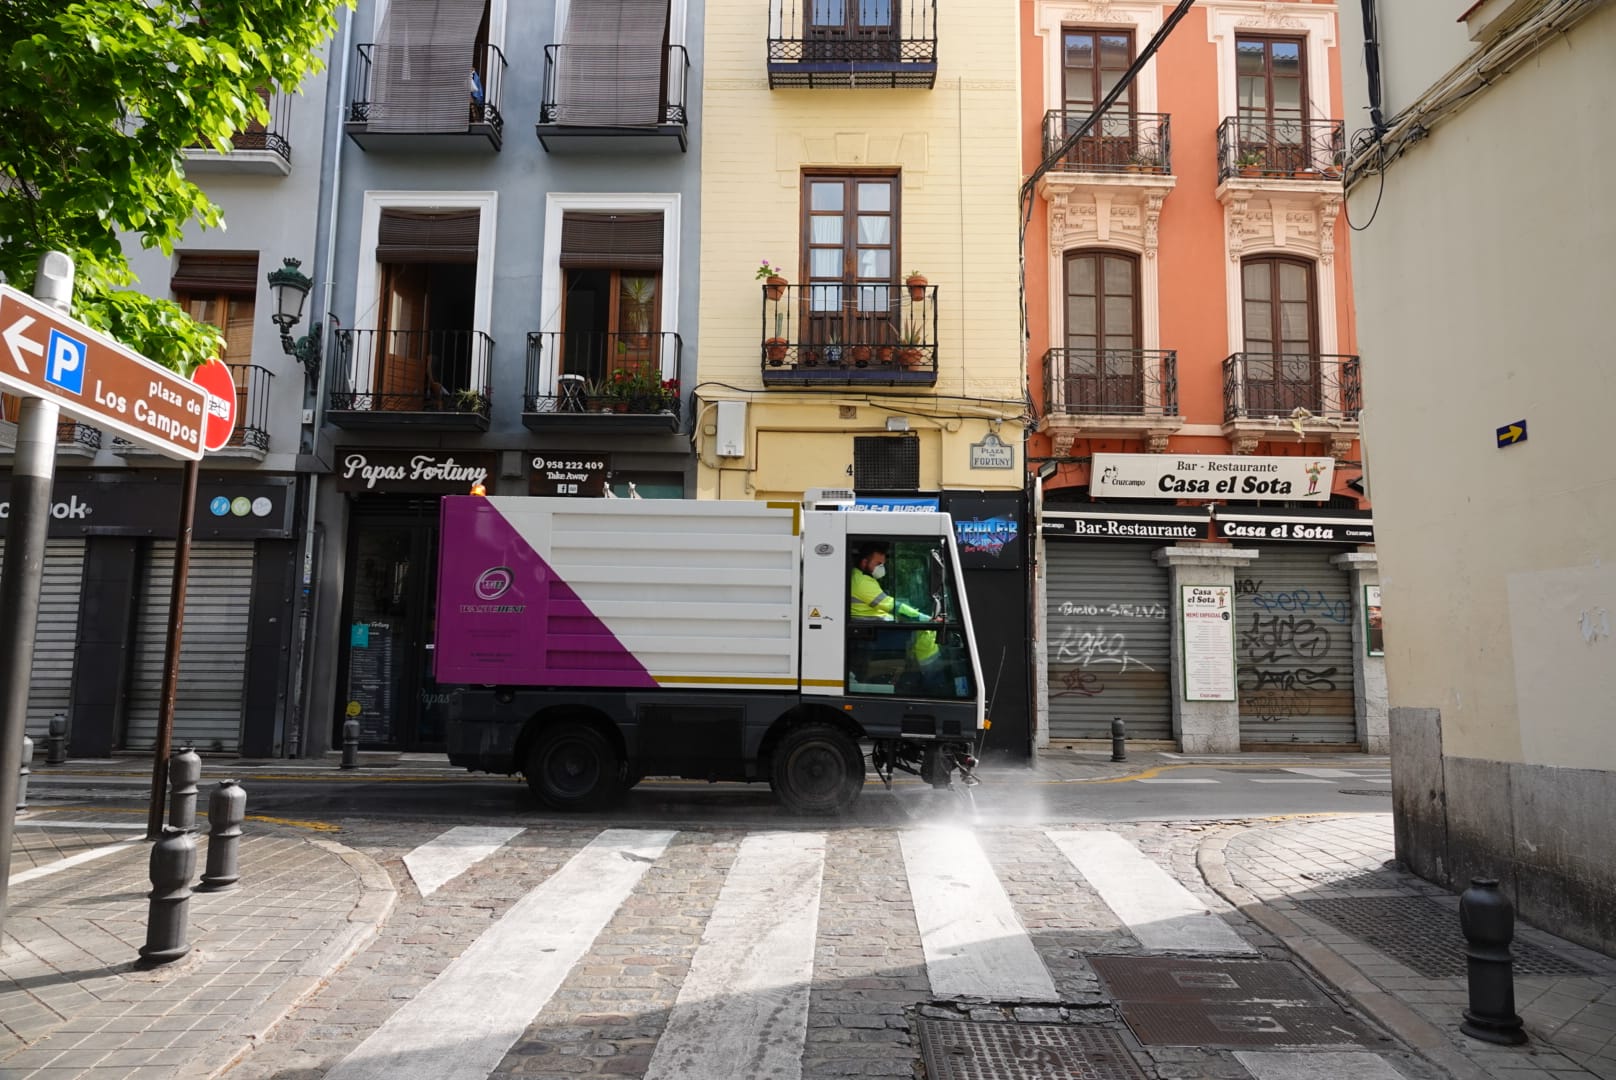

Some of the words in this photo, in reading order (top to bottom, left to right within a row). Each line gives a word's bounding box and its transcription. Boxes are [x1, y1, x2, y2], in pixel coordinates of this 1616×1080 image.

[52, 337, 80, 382] P
[149, 381, 182, 407] plaza
[187, 399, 200, 415] de
[95, 380, 126, 414] Los
[134, 399, 198, 444] Campos
[546, 461, 563, 469] 958
[565, 461, 583, 470] 222
[585, 461, 604, 470] 409
[846, 464, 853, 476] 4
[974, 457, 1009, 466] FORTUNY
[1177, 460, 1197, 471] Bar
[1208, 461, 1278, 472] Restaurante
[343, 454, 406, 488] Papas
[410, 455, 488, 488] Fortuny
[546, 471, 566, 480] Take
[566, 472, 588, 482] Away
[1112, 478, 1146, 487] Cruzcampo
[1158, 474, 1210, 493] Casa
[1215, 476, 1238, 493] el
[1241, 477, 1292, 495] Sota
[1075, 519, 1196, 537] Bar-Restaurante
[1224, 522, 1266, 537] Casa
[1271, 524, 1288, 538] el
[1292, 525, 1334, 539] Sota
